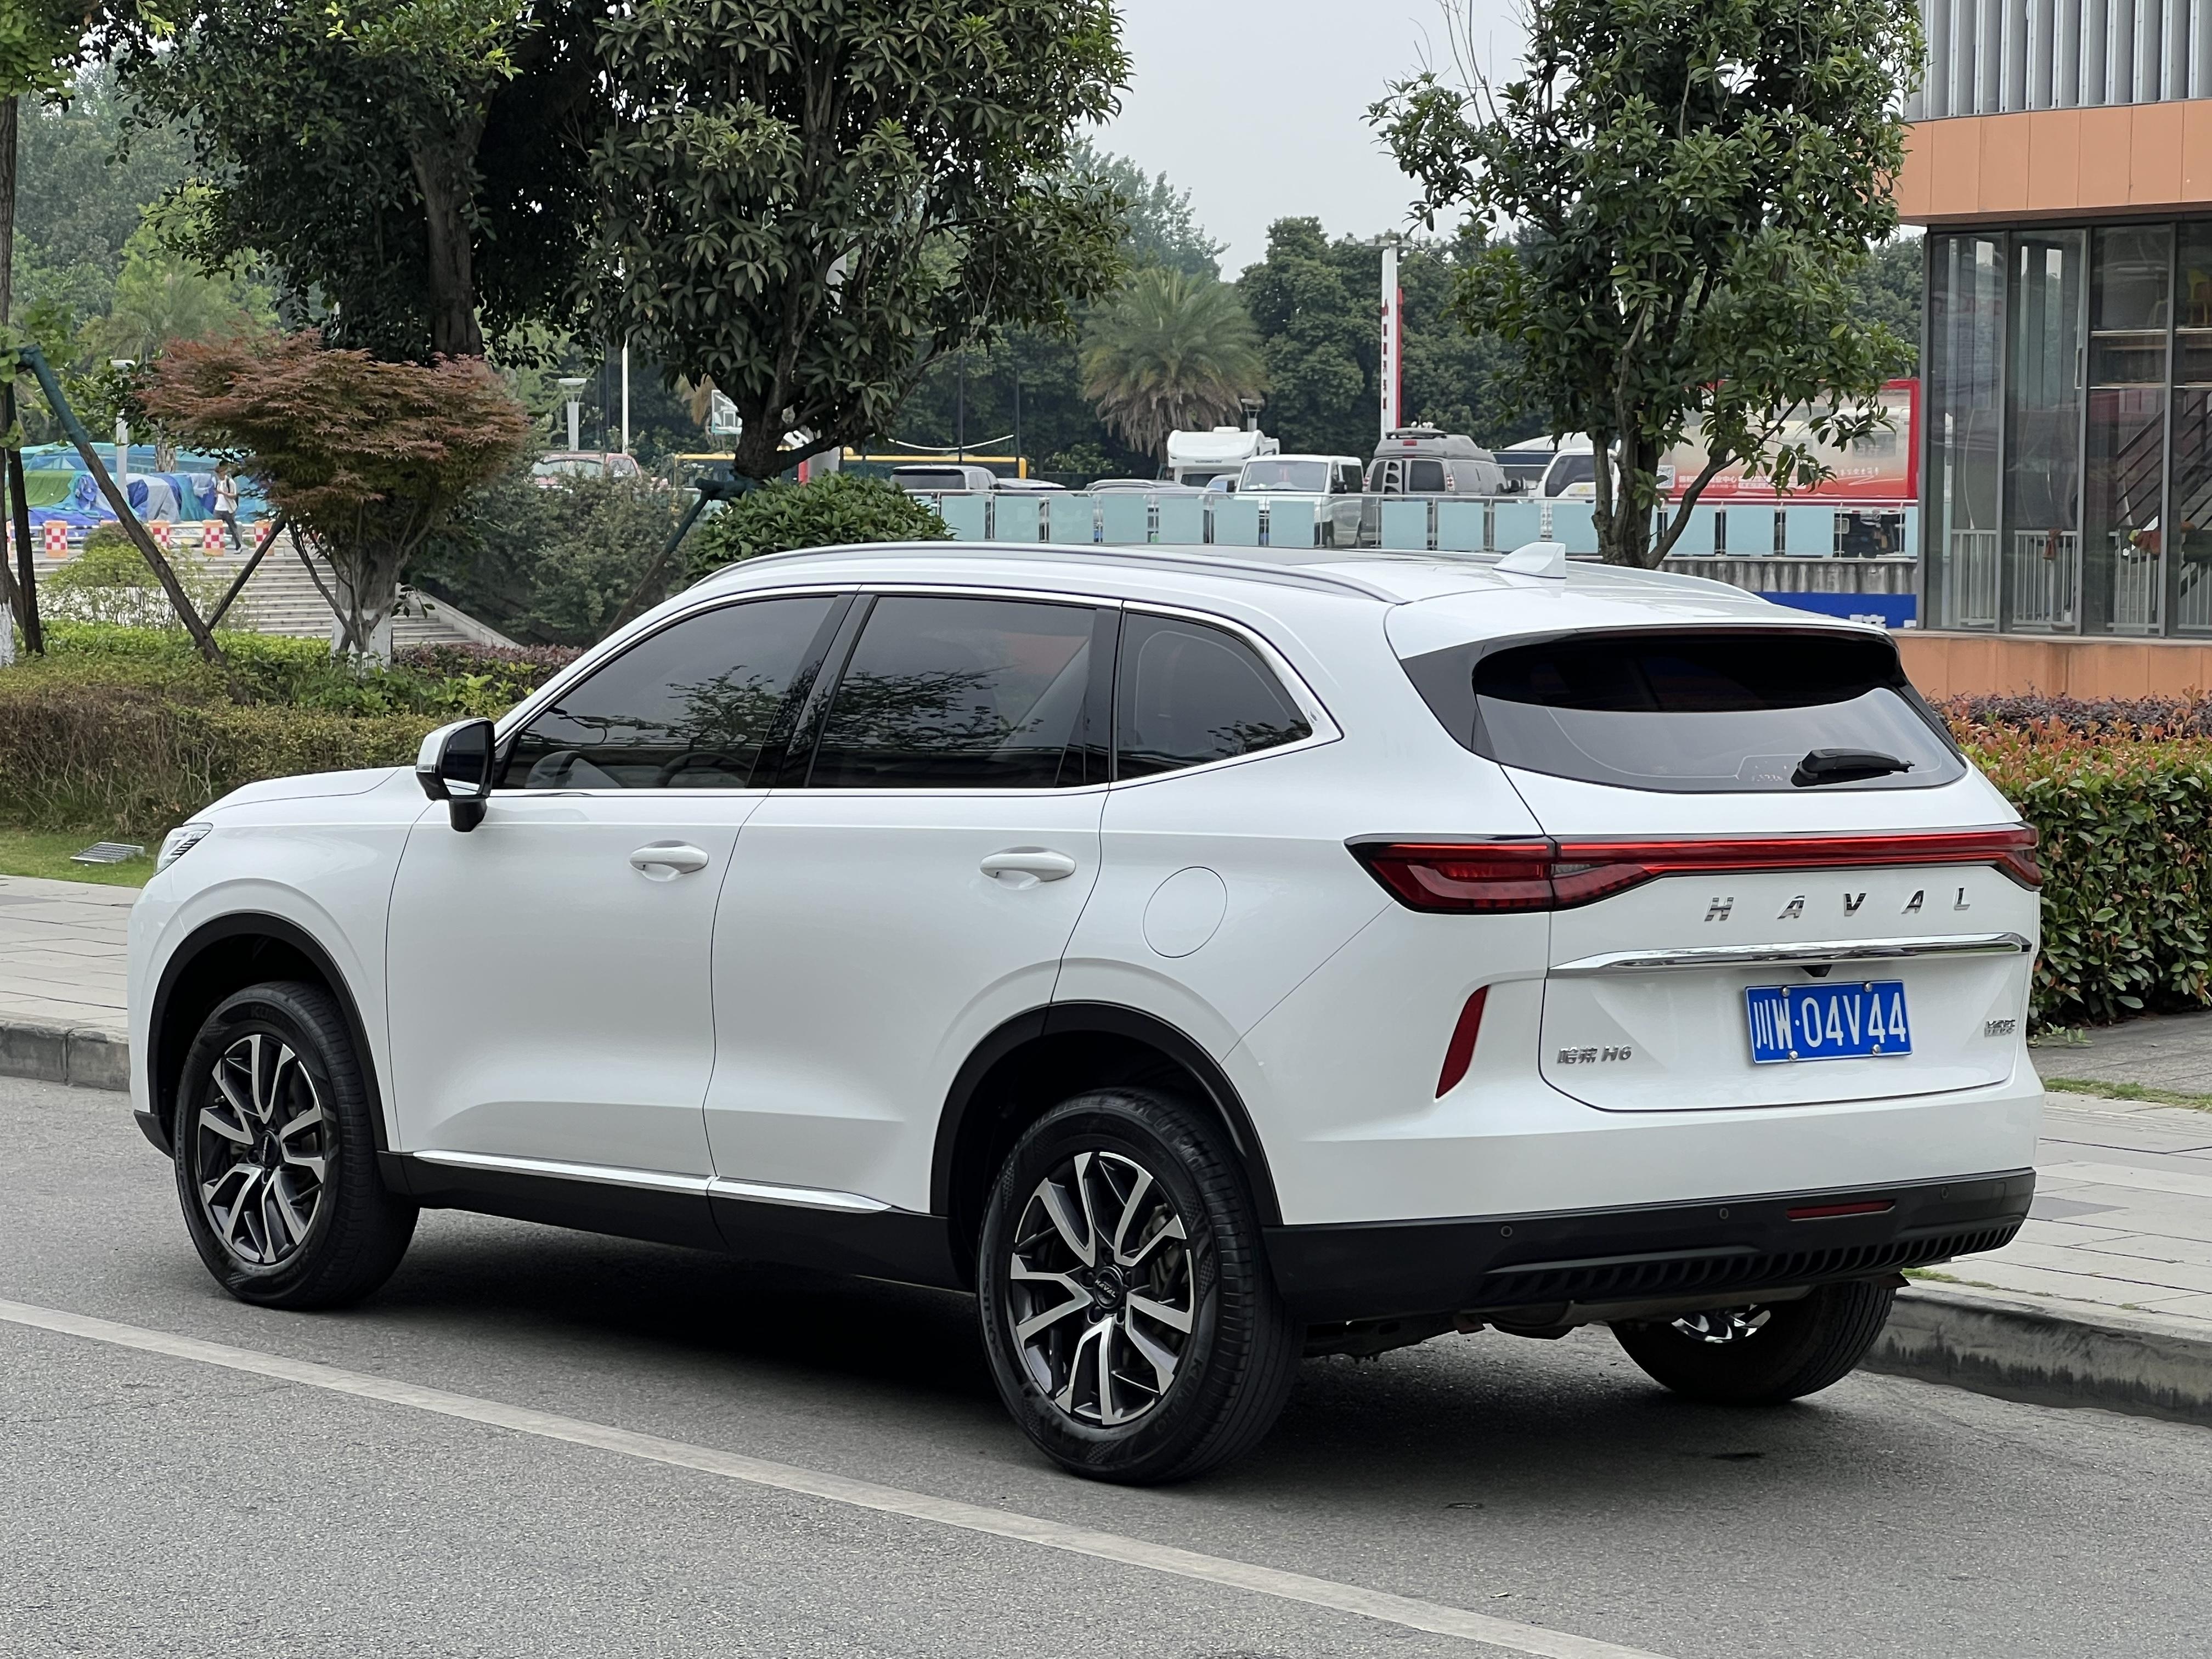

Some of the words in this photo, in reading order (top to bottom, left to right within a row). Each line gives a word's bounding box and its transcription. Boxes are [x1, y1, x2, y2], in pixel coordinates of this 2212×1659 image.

[1704, 887, 1971, 922] HAVAL
[1600, 1045, 1632, 1062] H6
[1094, 1279, 1116, 1298] HAVAL
